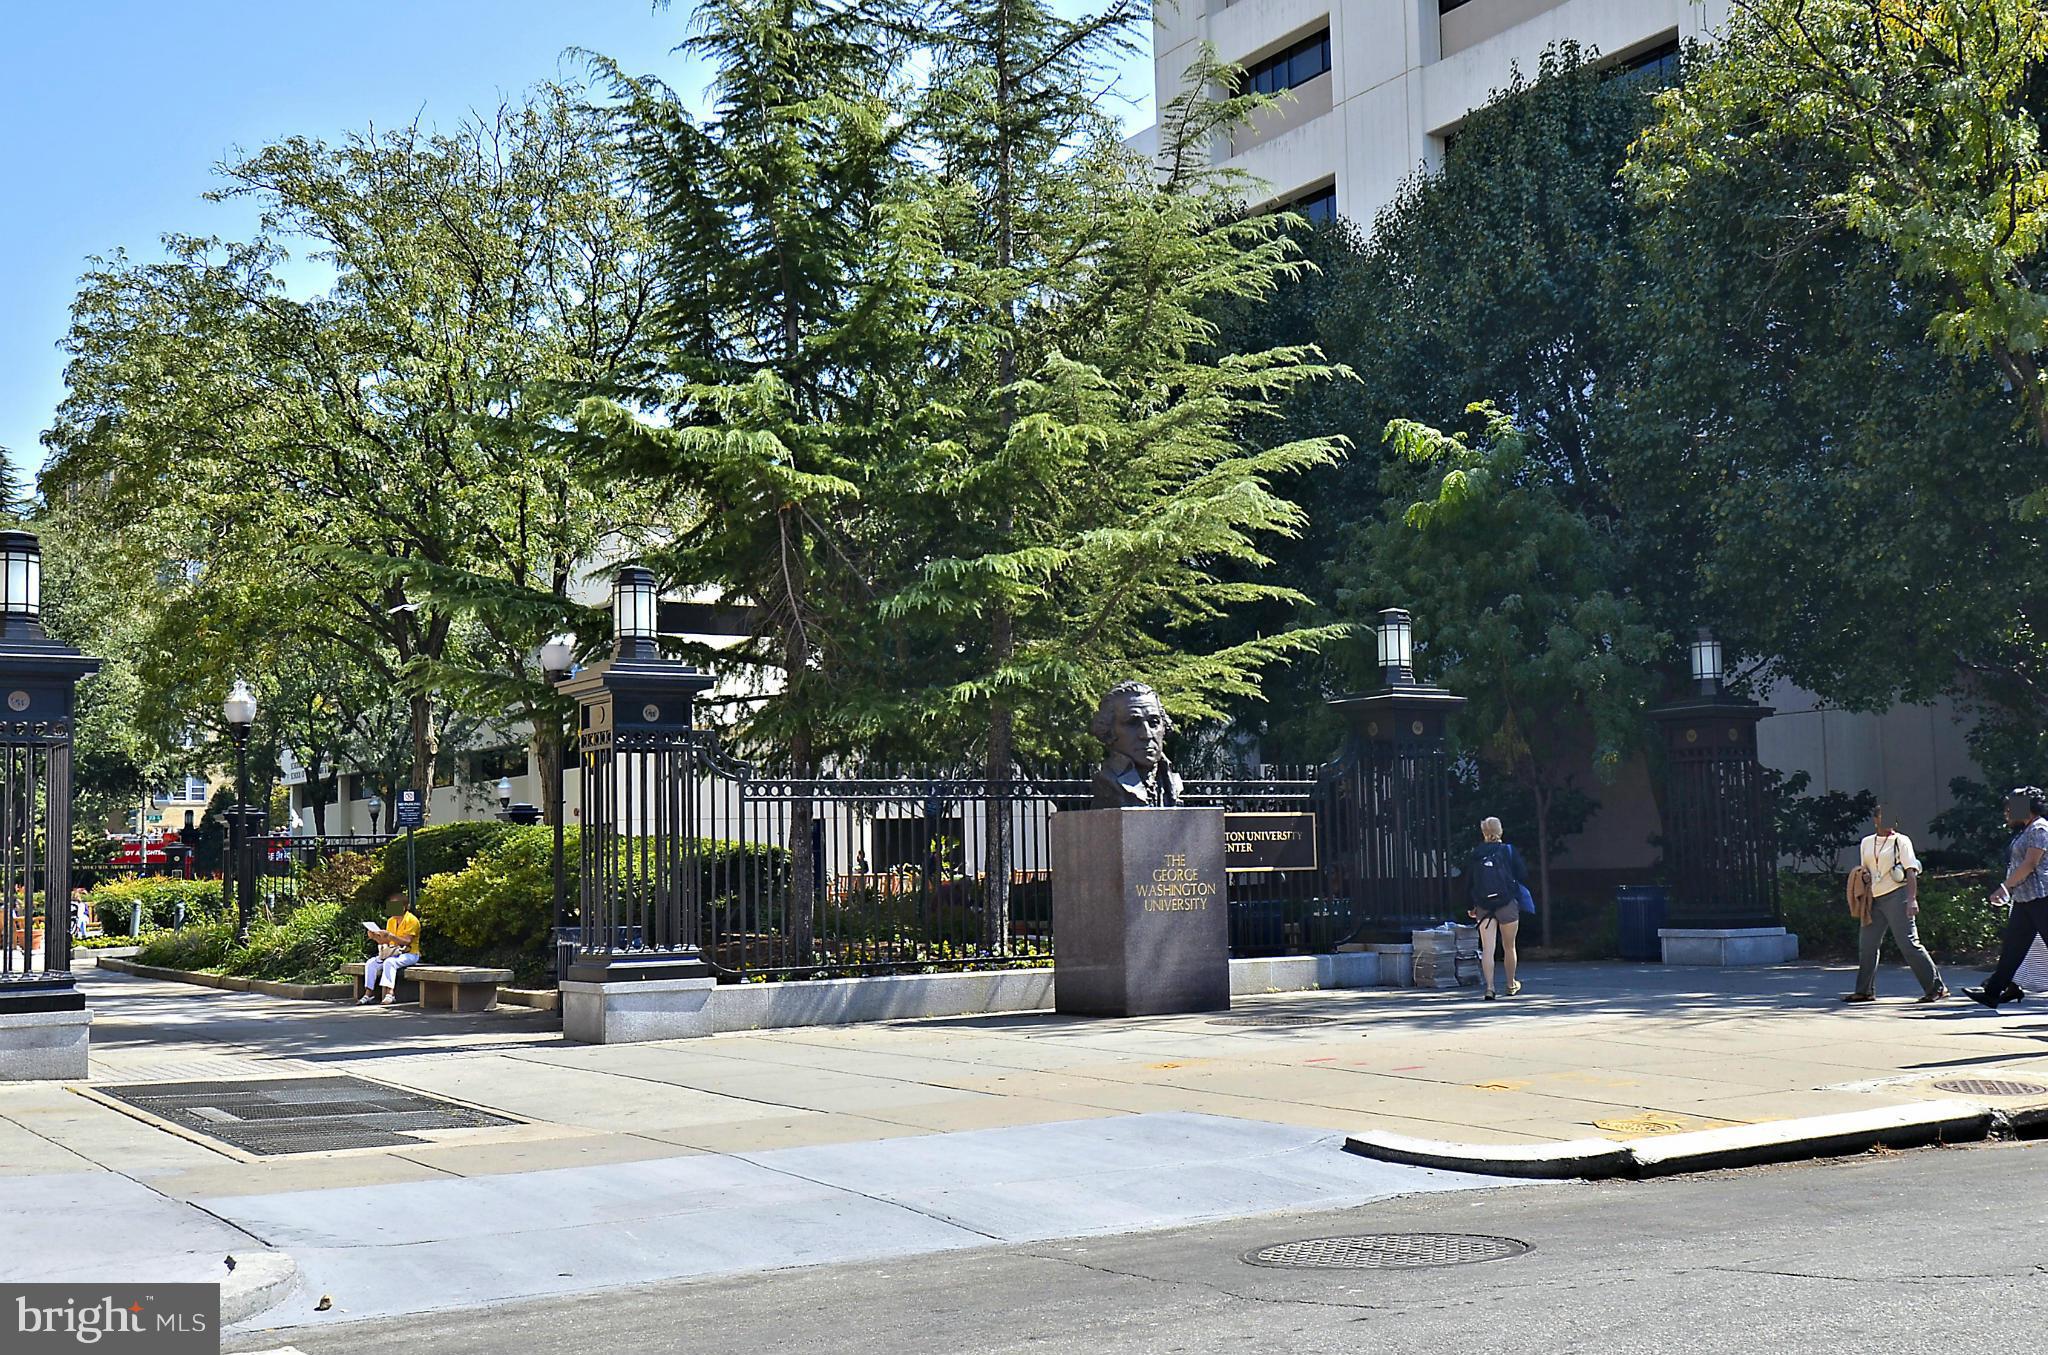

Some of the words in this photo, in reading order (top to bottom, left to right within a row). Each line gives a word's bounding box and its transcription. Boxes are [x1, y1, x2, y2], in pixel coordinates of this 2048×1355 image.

[1225, 831, 1246, 841] TON
[1246, 831, 1303, 841] UNIVERSITY
[1225, 843, 1253, 853] ENTER
[1164, 854, 1186, 867] THE
[1152, 868, 1199, 882] GEORGE
[1135, 882, 1216, 897] WASHINGTON
[1144, 897, 1207, 912] UNIVERSITY
